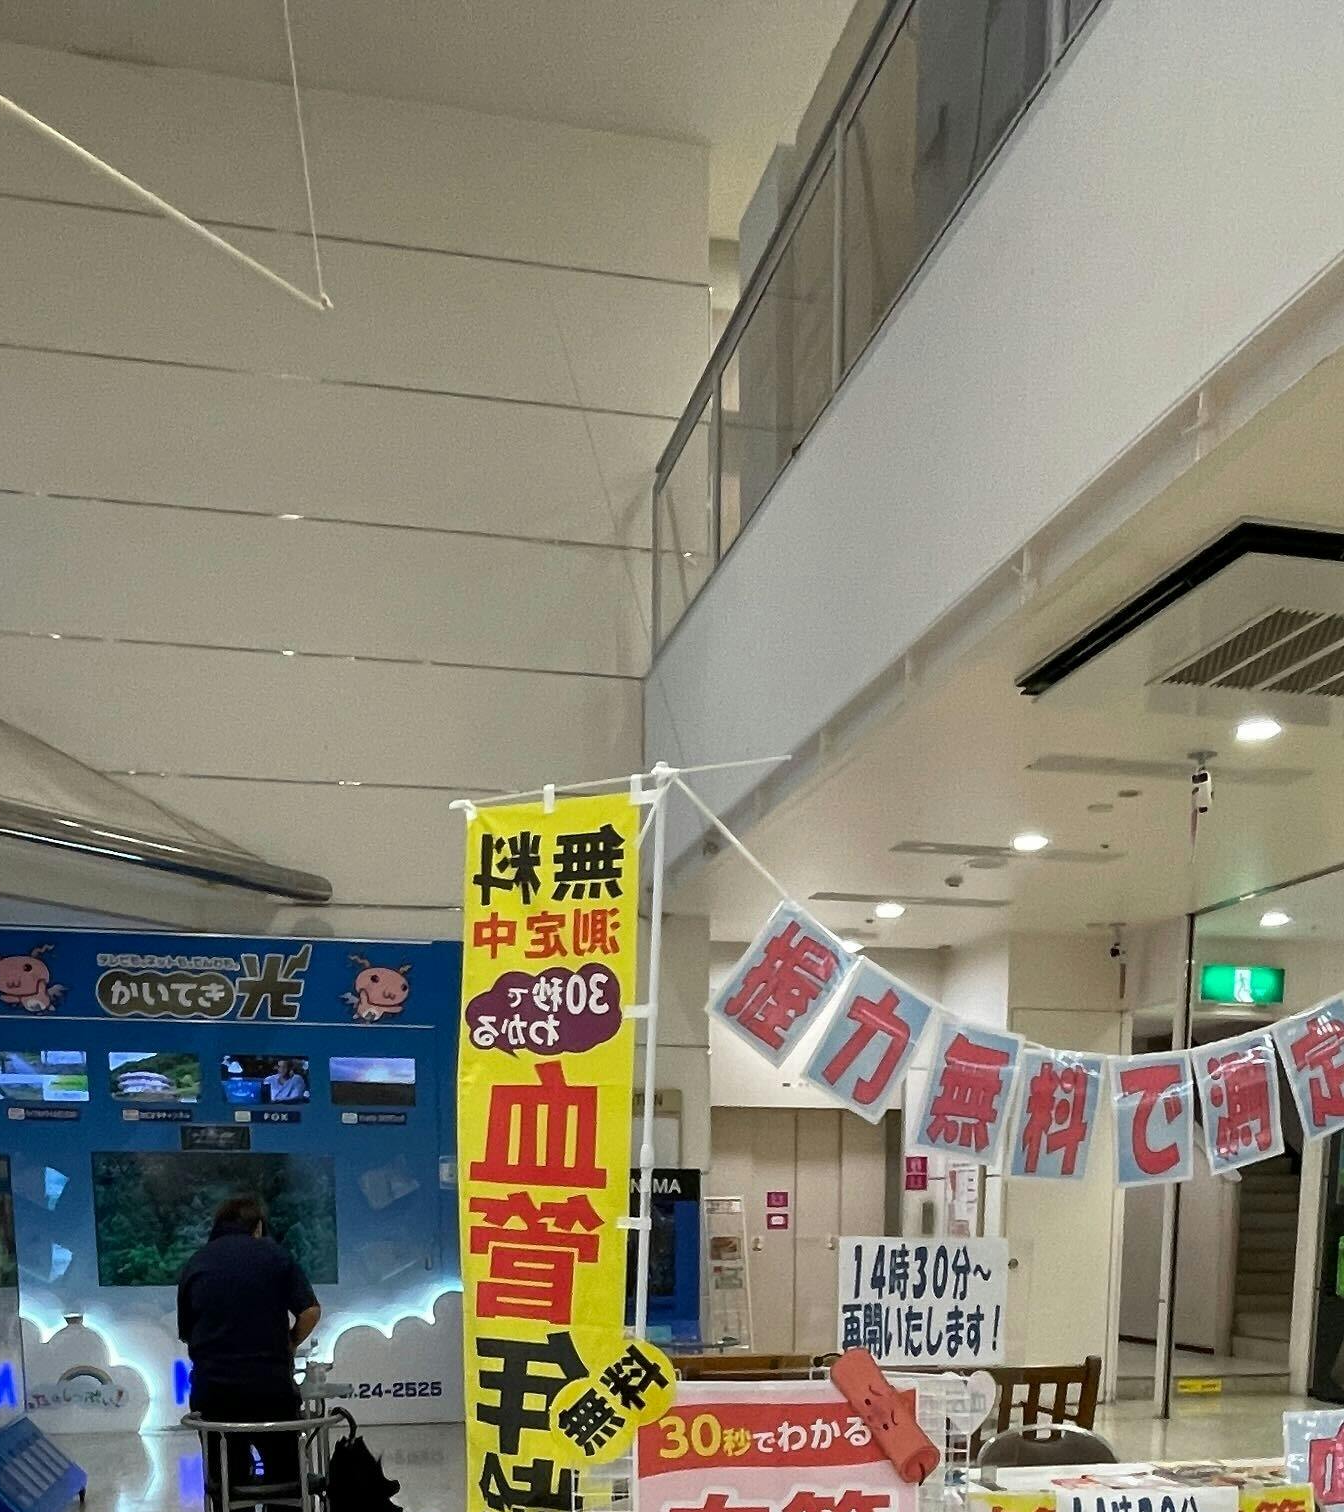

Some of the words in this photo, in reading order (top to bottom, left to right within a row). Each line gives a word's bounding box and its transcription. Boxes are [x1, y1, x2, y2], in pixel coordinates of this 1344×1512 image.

[841, 1303, 1002, 1359] 再開いたします!
[557, 1344, 670, 1456] 無料
[657, 1414, 872, 1459] 30秒でわかる
